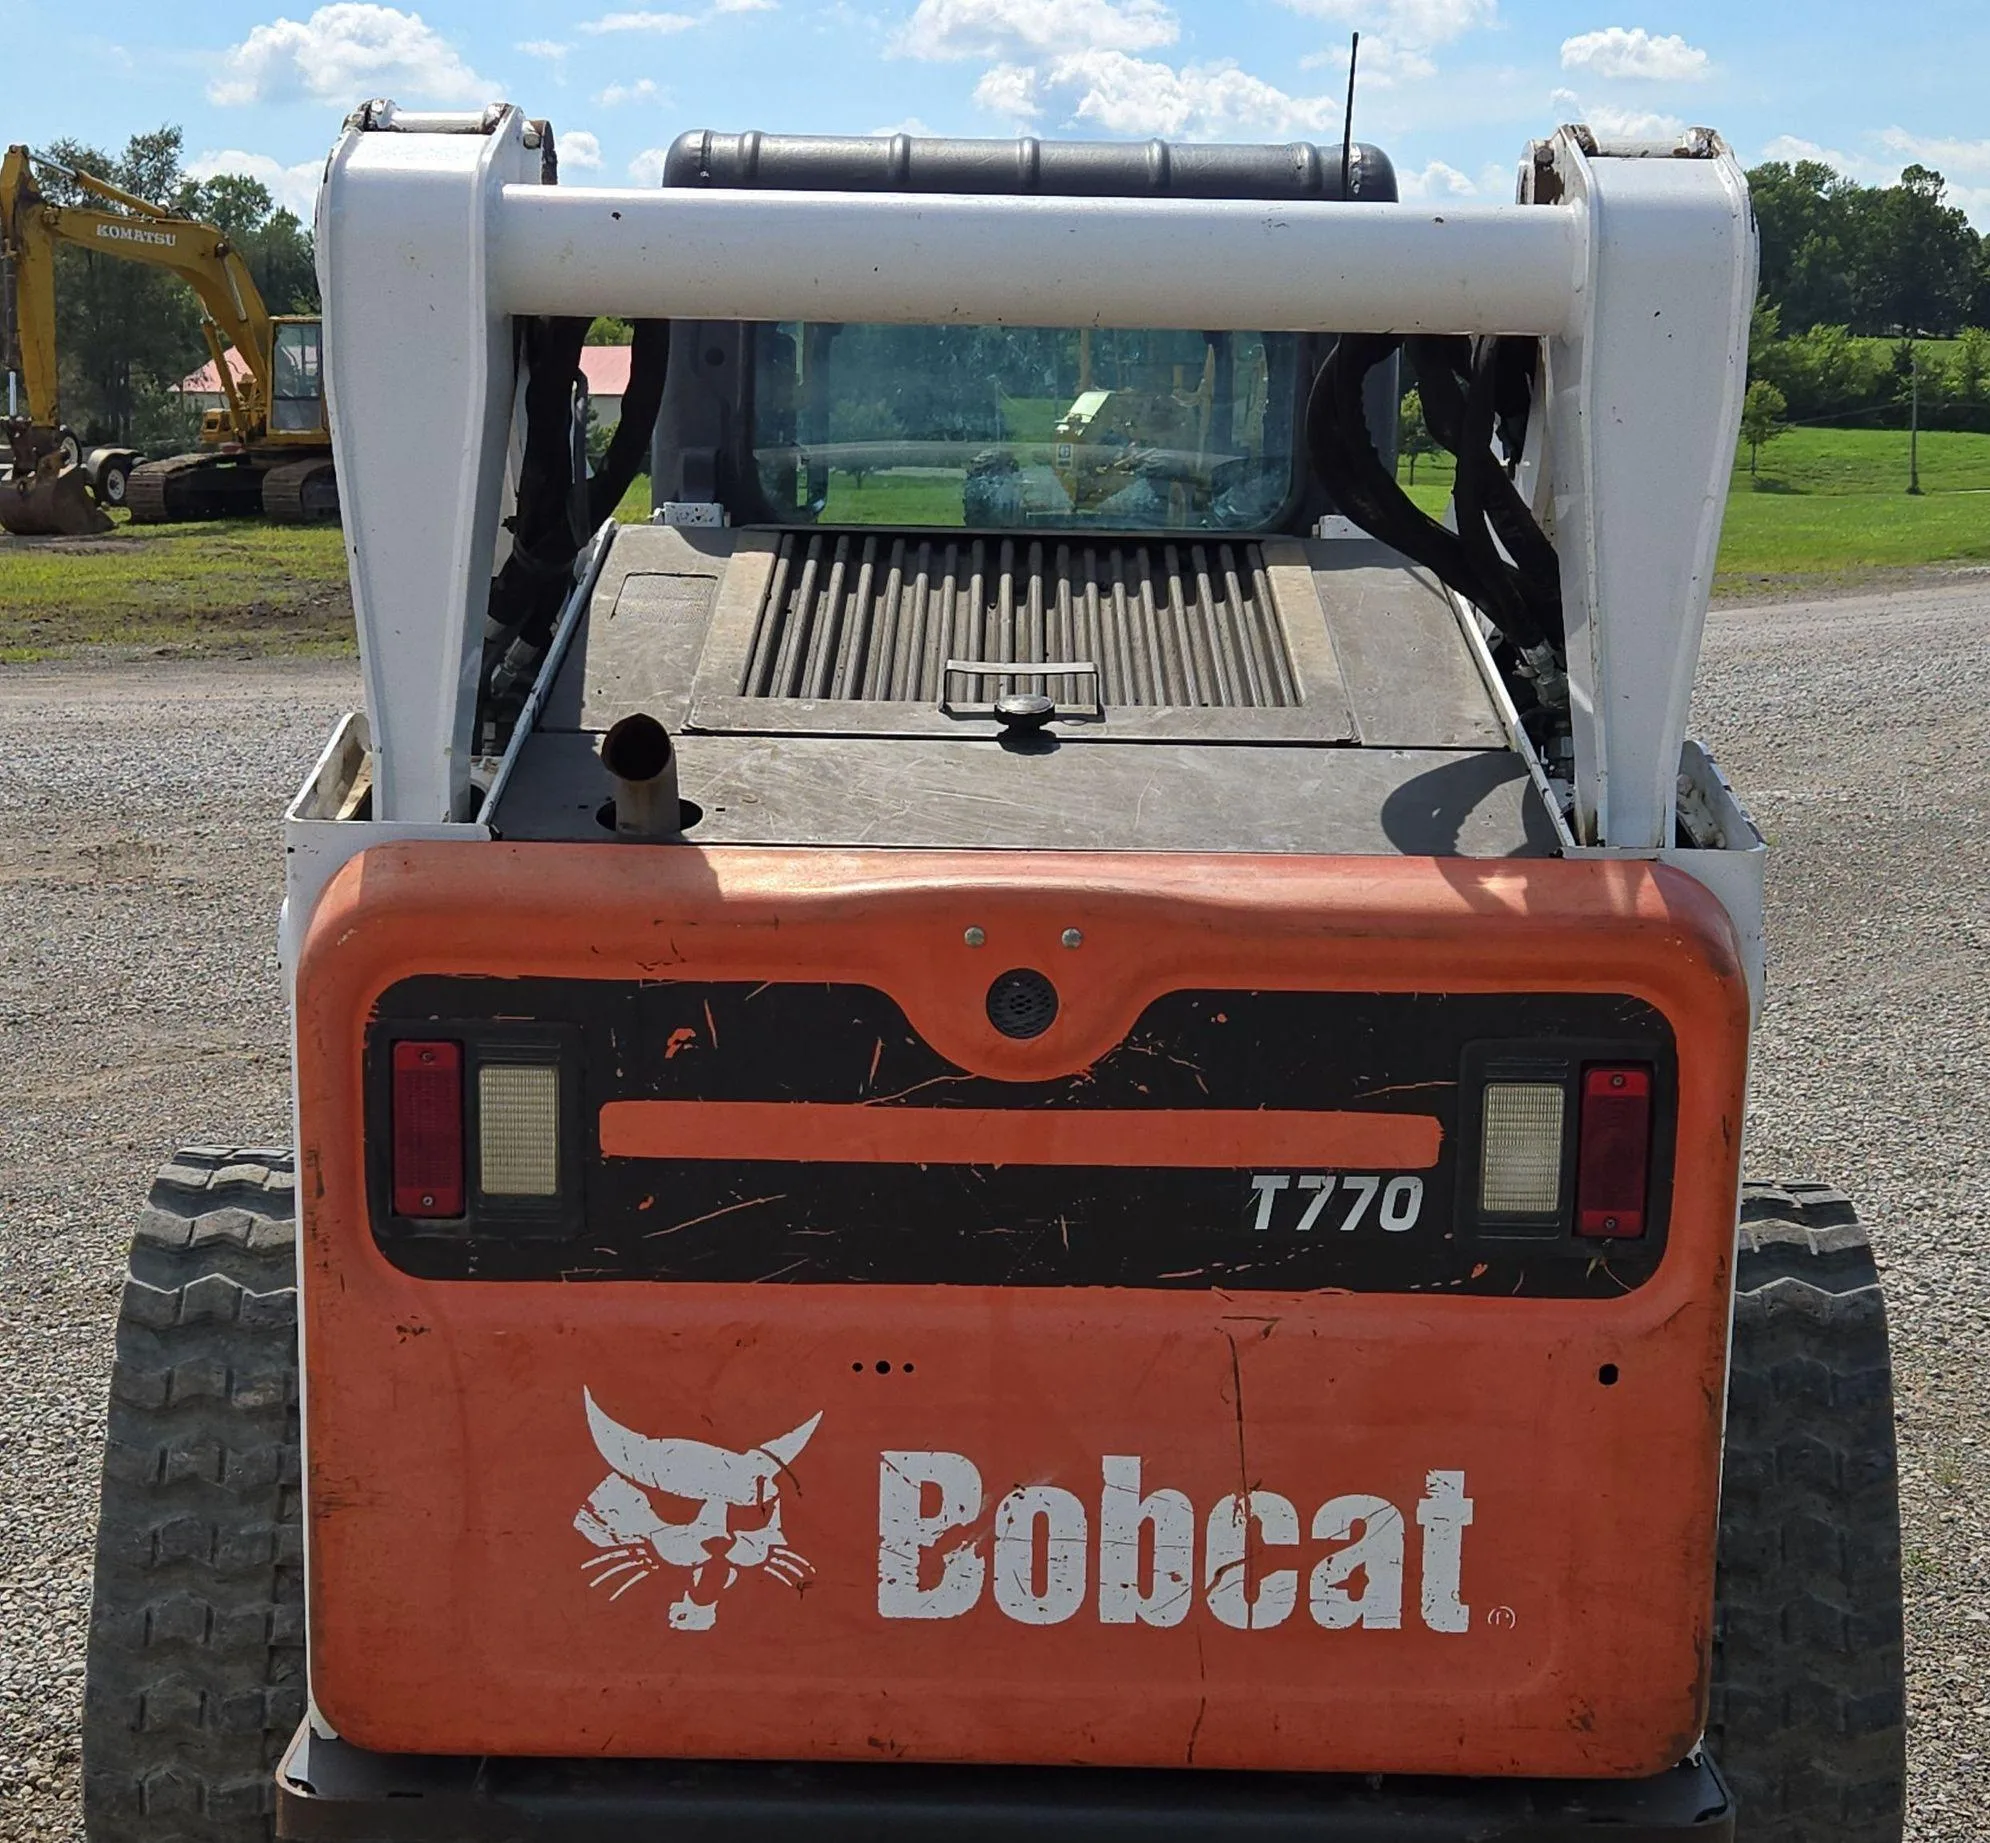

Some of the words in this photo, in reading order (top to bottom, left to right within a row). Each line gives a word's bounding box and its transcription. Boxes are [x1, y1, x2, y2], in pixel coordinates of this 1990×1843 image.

[96, 224, 176, 246] KOMATSU
[1251, 1175, 1424, 1232] T770
[878, 1450, 1473, 1633] Bobcat
